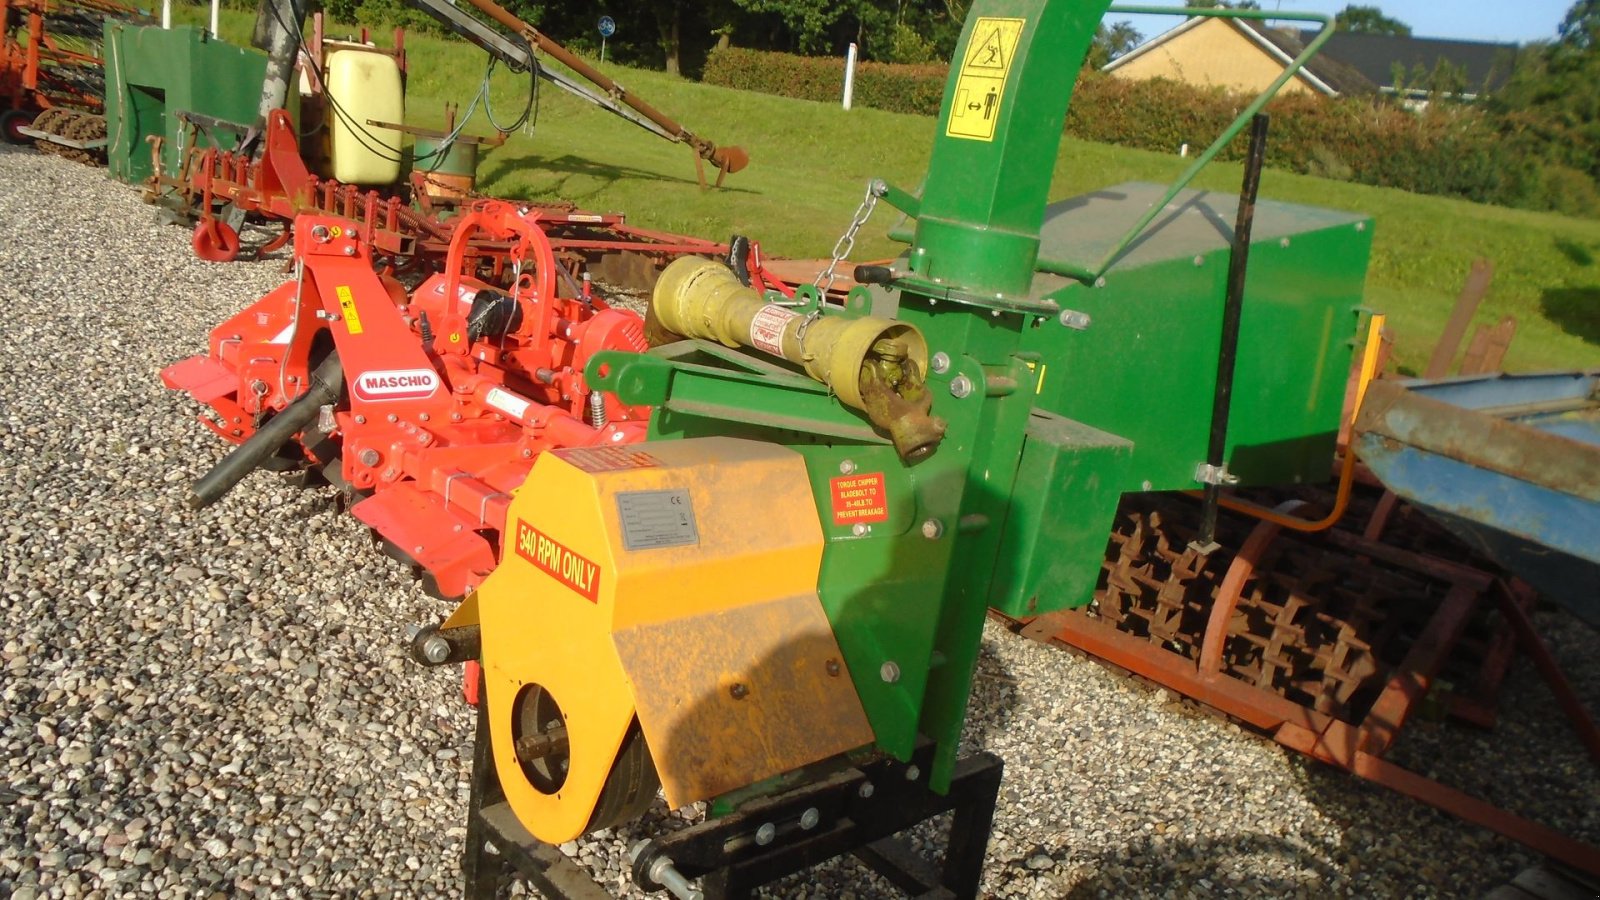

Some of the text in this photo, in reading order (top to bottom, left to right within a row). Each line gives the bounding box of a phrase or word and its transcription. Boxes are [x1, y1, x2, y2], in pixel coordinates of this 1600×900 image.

[365, 375, 432, 389] MASCHIO
[837, 478, 878, 489] TORQUE CHIPPER
[840, 489, 868, 499] BLADEBOLT
[866, 498, 873, 506] TO
[837, 507, 884, 519] PREVENT BREAKAGE
[519, 524, 596, 593] 540 RPM ONLY
